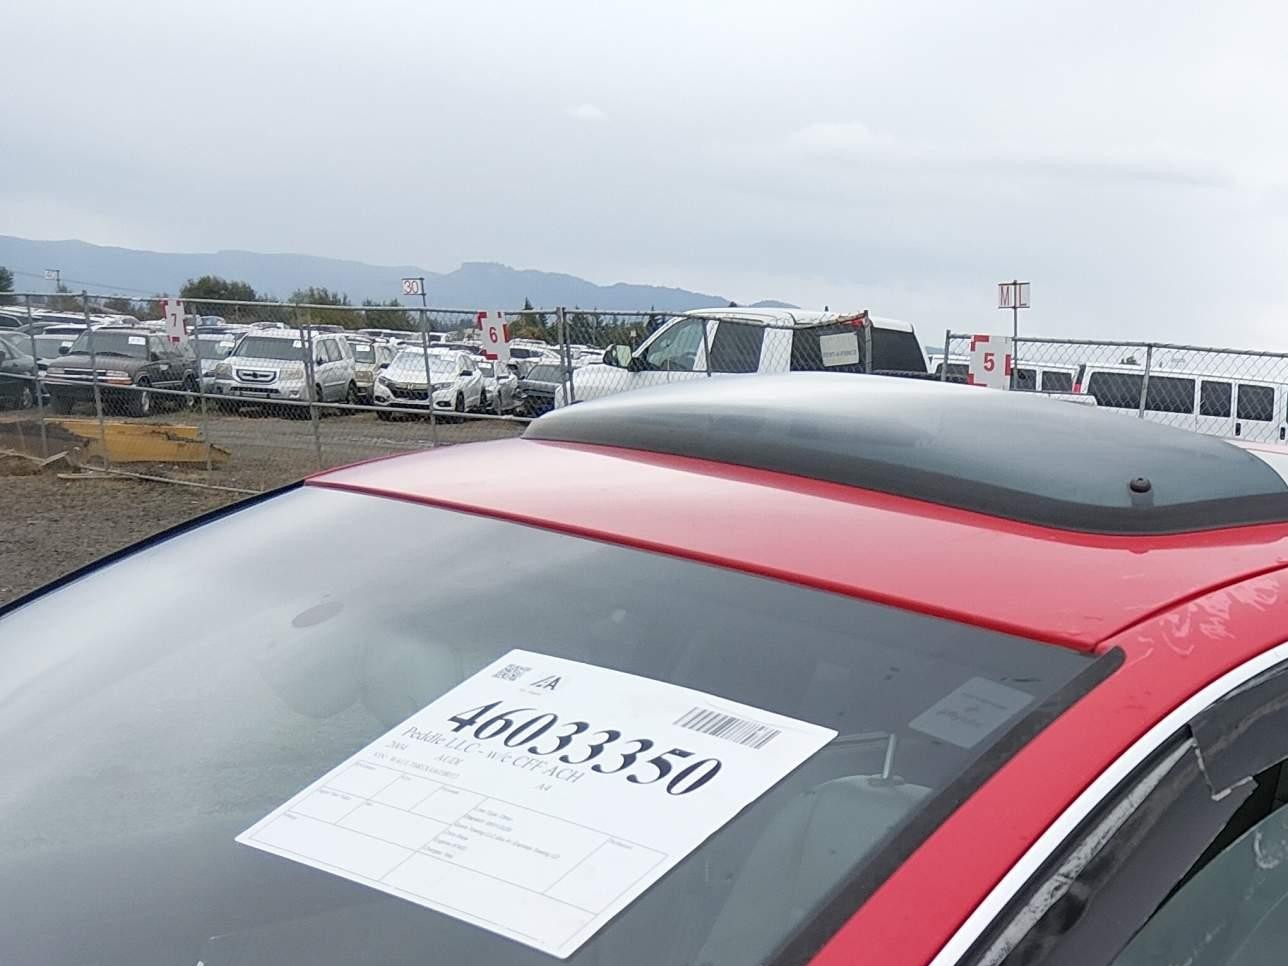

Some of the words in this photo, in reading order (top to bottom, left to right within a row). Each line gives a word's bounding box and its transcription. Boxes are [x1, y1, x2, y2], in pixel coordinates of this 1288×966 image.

[404, 280, 419, 295] 30
[1000, 285, 1010, 306] M
[1019, 284, 1027, 306] L
[170, 312, 177, 328] 7
[489, 326, 498, 344] 6
[983, 352, 995, 372] 5
[402, 726, 447, 746] Peddle
[445, 733, 481, 753] LLC
[543, 764, 586, 784] ACH
[447, 700, 722, 796] 46033350
